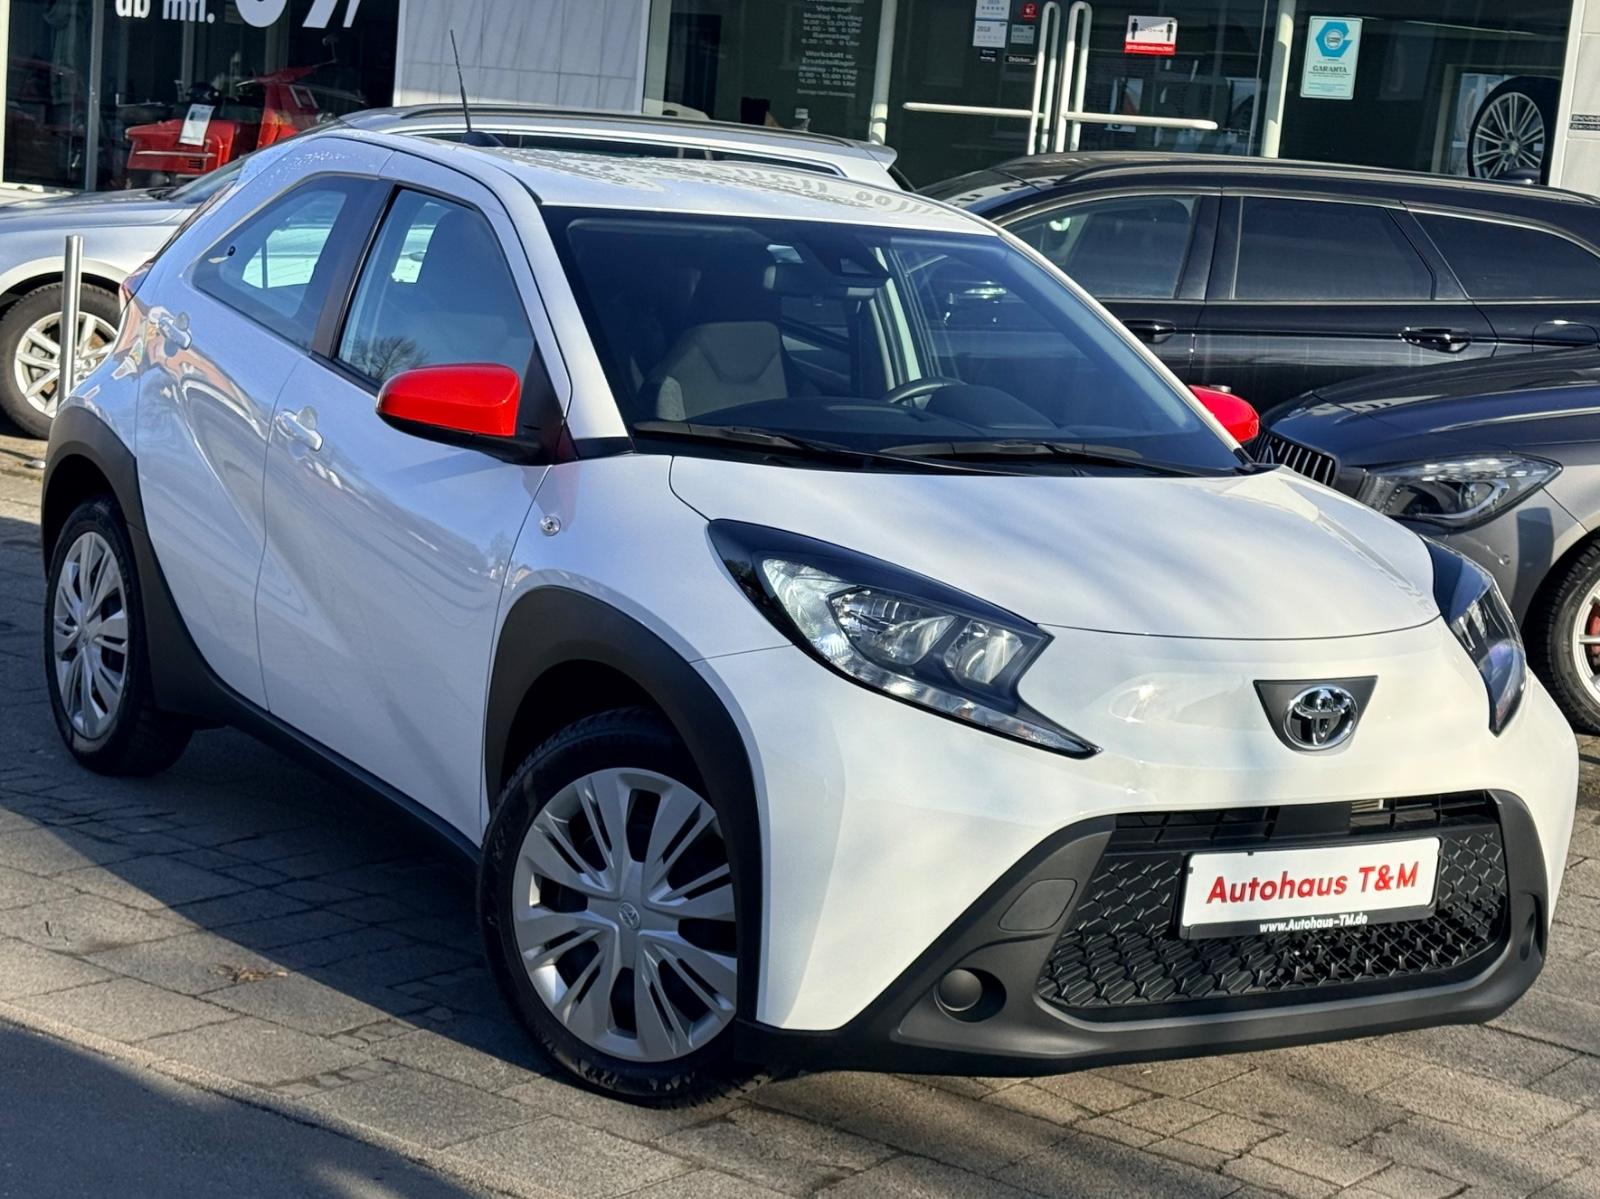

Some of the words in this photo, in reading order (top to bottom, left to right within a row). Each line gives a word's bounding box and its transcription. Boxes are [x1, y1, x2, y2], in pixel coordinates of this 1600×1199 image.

[1206, 871, 1348, 904] Autohaus
[1359, 861, 1420, 893] T&M
[1260, 912, 1369, 933] www.Autohaus-TM.de
